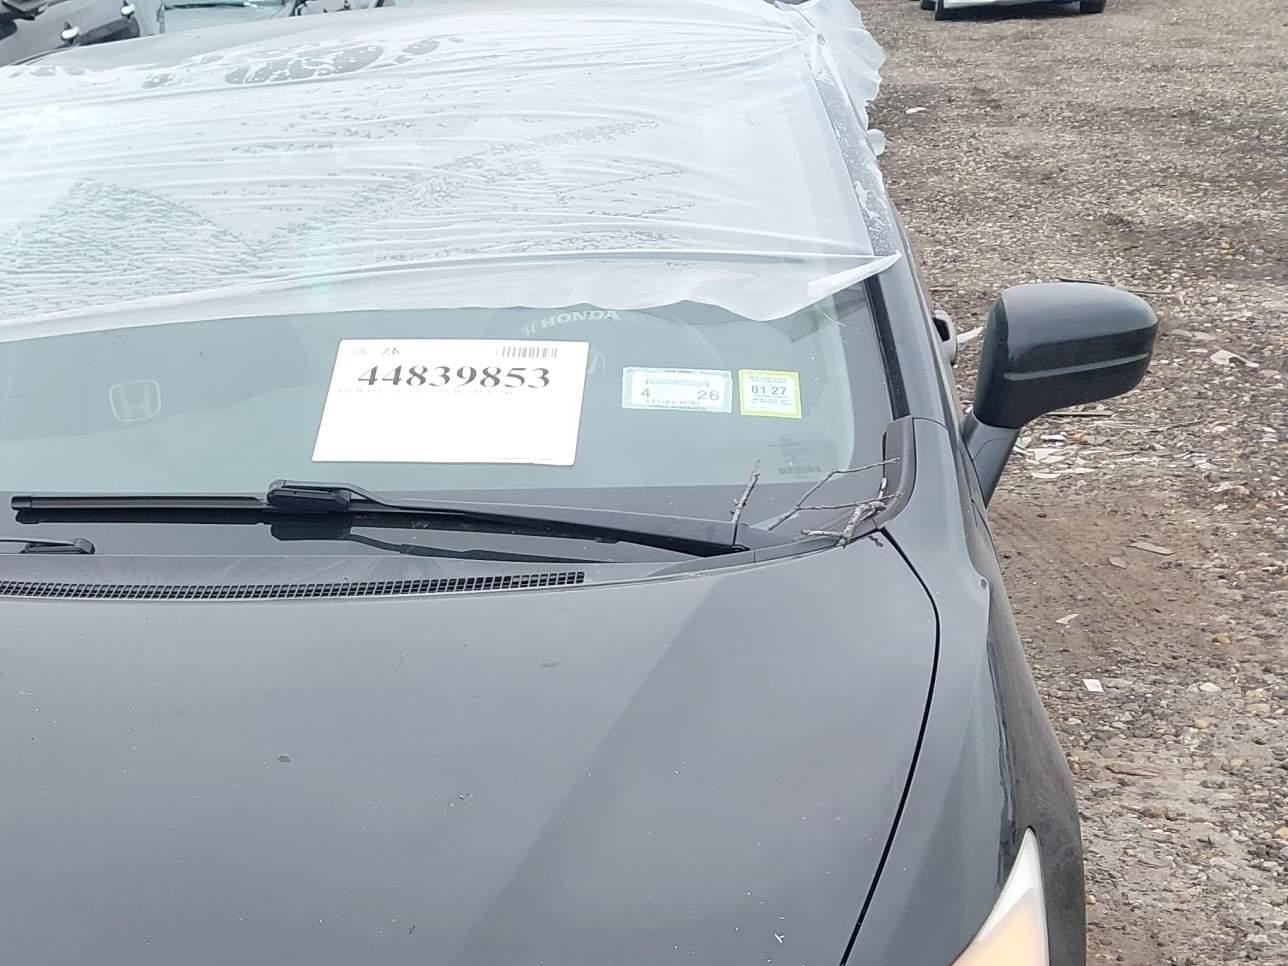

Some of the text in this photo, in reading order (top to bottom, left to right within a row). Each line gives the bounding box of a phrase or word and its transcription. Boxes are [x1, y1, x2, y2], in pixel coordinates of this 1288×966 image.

[540, 310, 622, 329] HONDA
[358, 365, 550, 388] 44839853
[697, 390, 720, 401] 26
